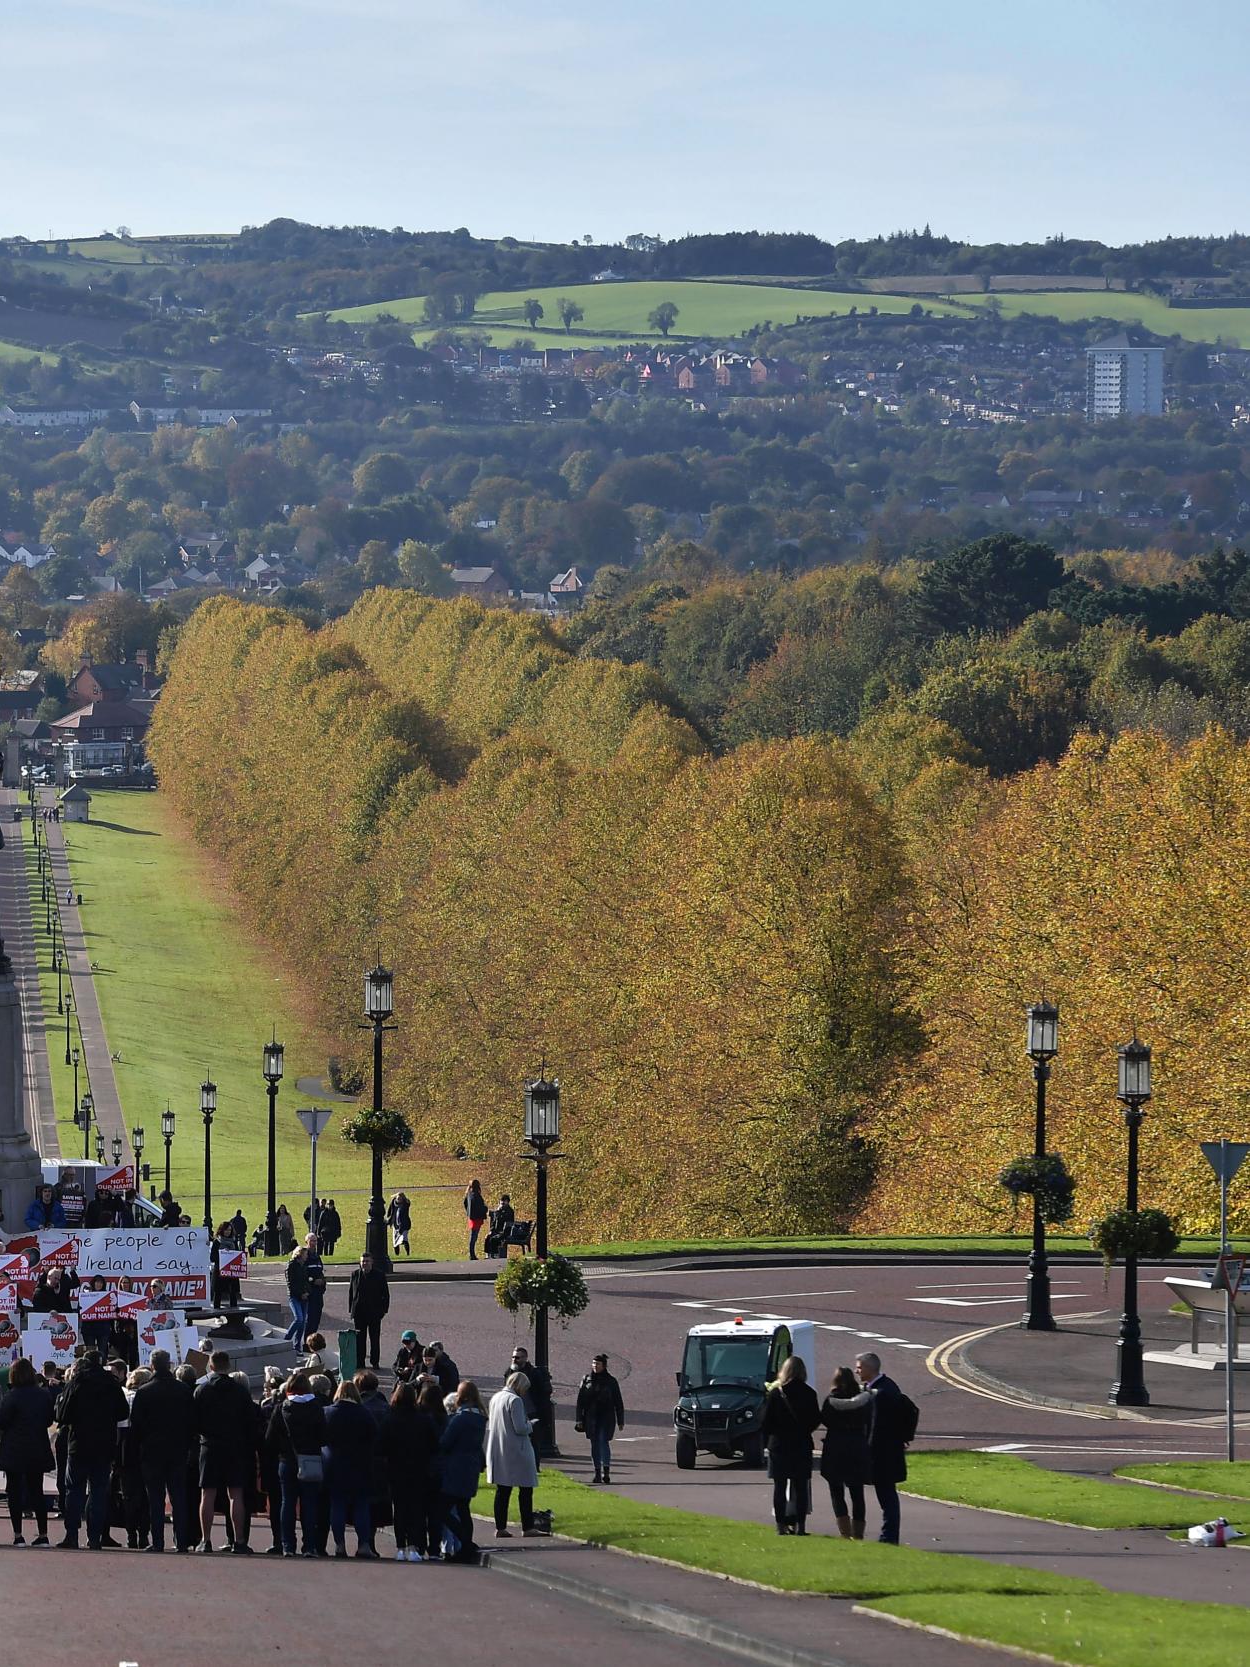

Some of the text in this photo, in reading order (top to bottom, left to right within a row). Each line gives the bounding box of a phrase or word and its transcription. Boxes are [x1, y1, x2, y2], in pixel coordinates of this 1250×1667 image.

[104, 1233, 163, 1251] people
[175, 1231, 198, 1250] of
[85, 1256, 143, 1271] Ireland
[164, 1280, 204, 1297] AME”
